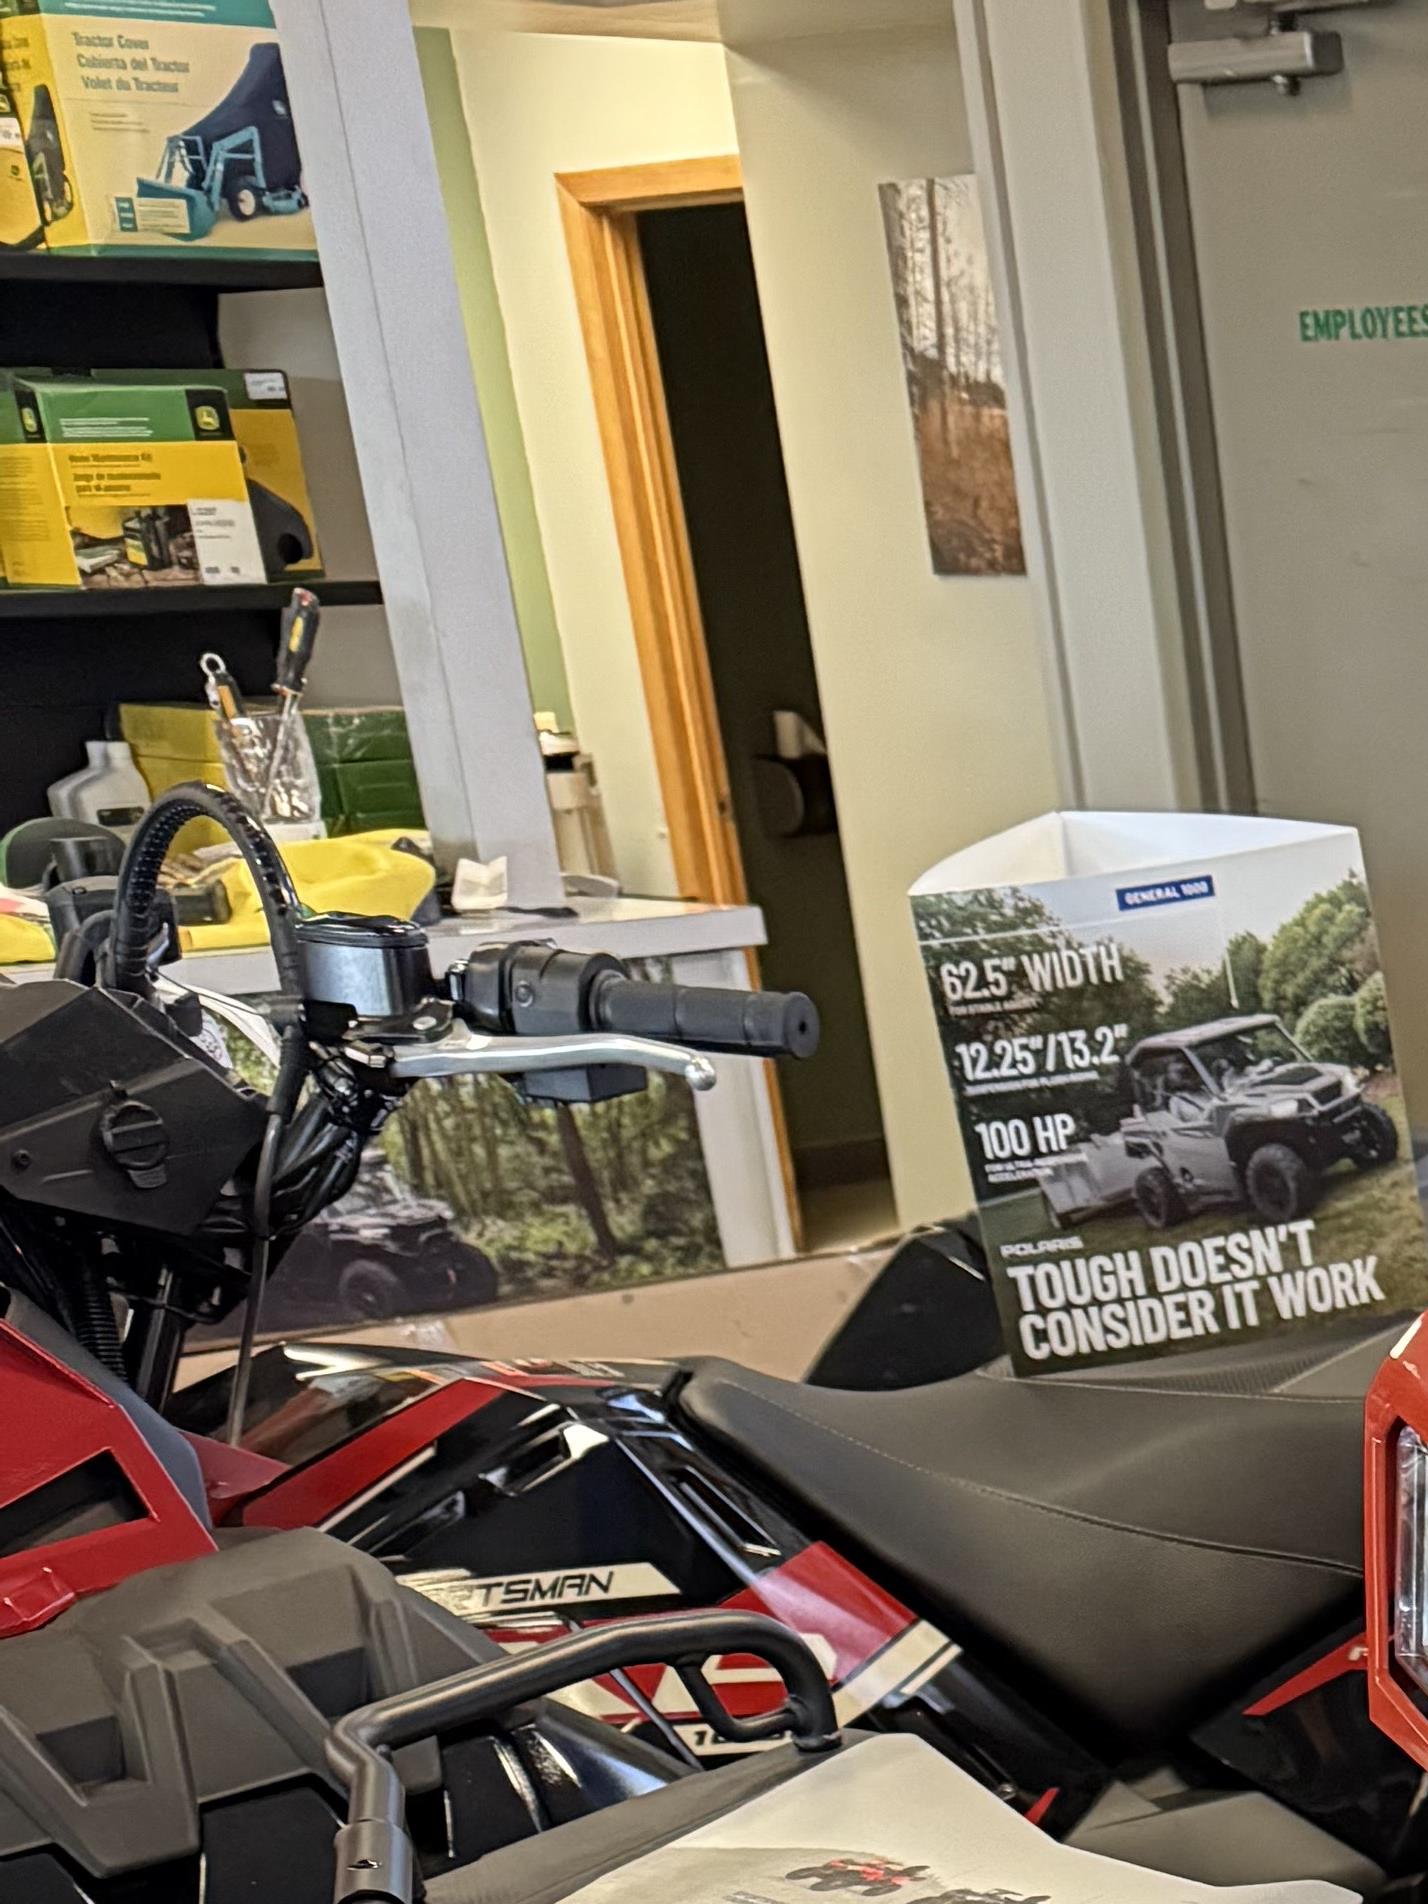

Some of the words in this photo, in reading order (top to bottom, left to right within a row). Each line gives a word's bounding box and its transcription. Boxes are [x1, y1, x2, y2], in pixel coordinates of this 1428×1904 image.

[1124, 885, 1180, 906] GENERAL
[940, 955, 1017, 1002] 62.5"
[1021, 942, 1125, 993] WIDTH
[955, 1024, 1128, 1082] 12.25"/13.2"
[975, 1118, 1031, 1160] 100
[1033, 1113, 1076, 1153] HP
[1000, 1236, 1084, 1257] POLARIS
[1007, 1245, 1143, 1312] TOUGH
[1148, 1220, 1316, 1291] DOESN'T
[1017, 1288, 1219, 1360] CONSIDER
[1218, 1283, 1260, 1328] IT
[1271, 1256, 1386, 1320] WORK
